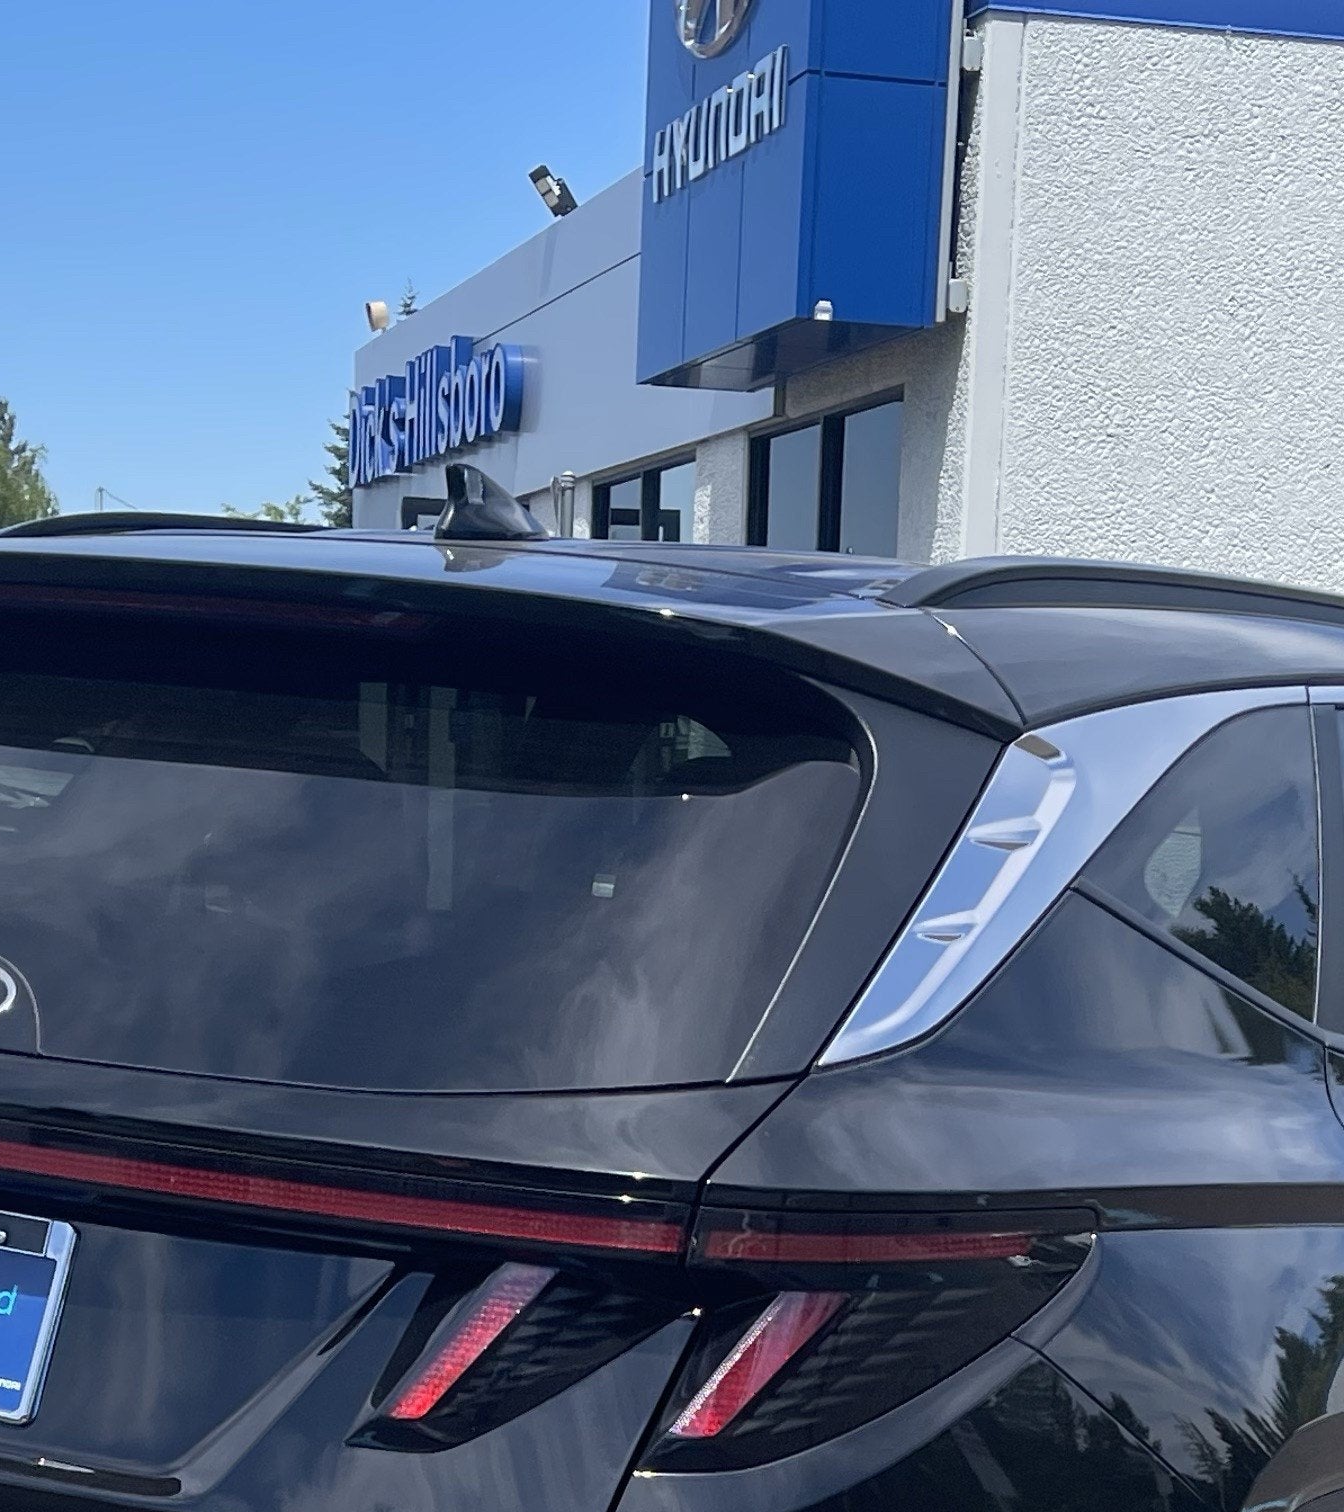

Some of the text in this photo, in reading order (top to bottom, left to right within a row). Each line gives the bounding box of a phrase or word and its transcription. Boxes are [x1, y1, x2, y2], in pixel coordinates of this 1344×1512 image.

[652, 43, 788, 203] HYUNDAI
[348, 334, 520, 490] Dick's Hillsboro
